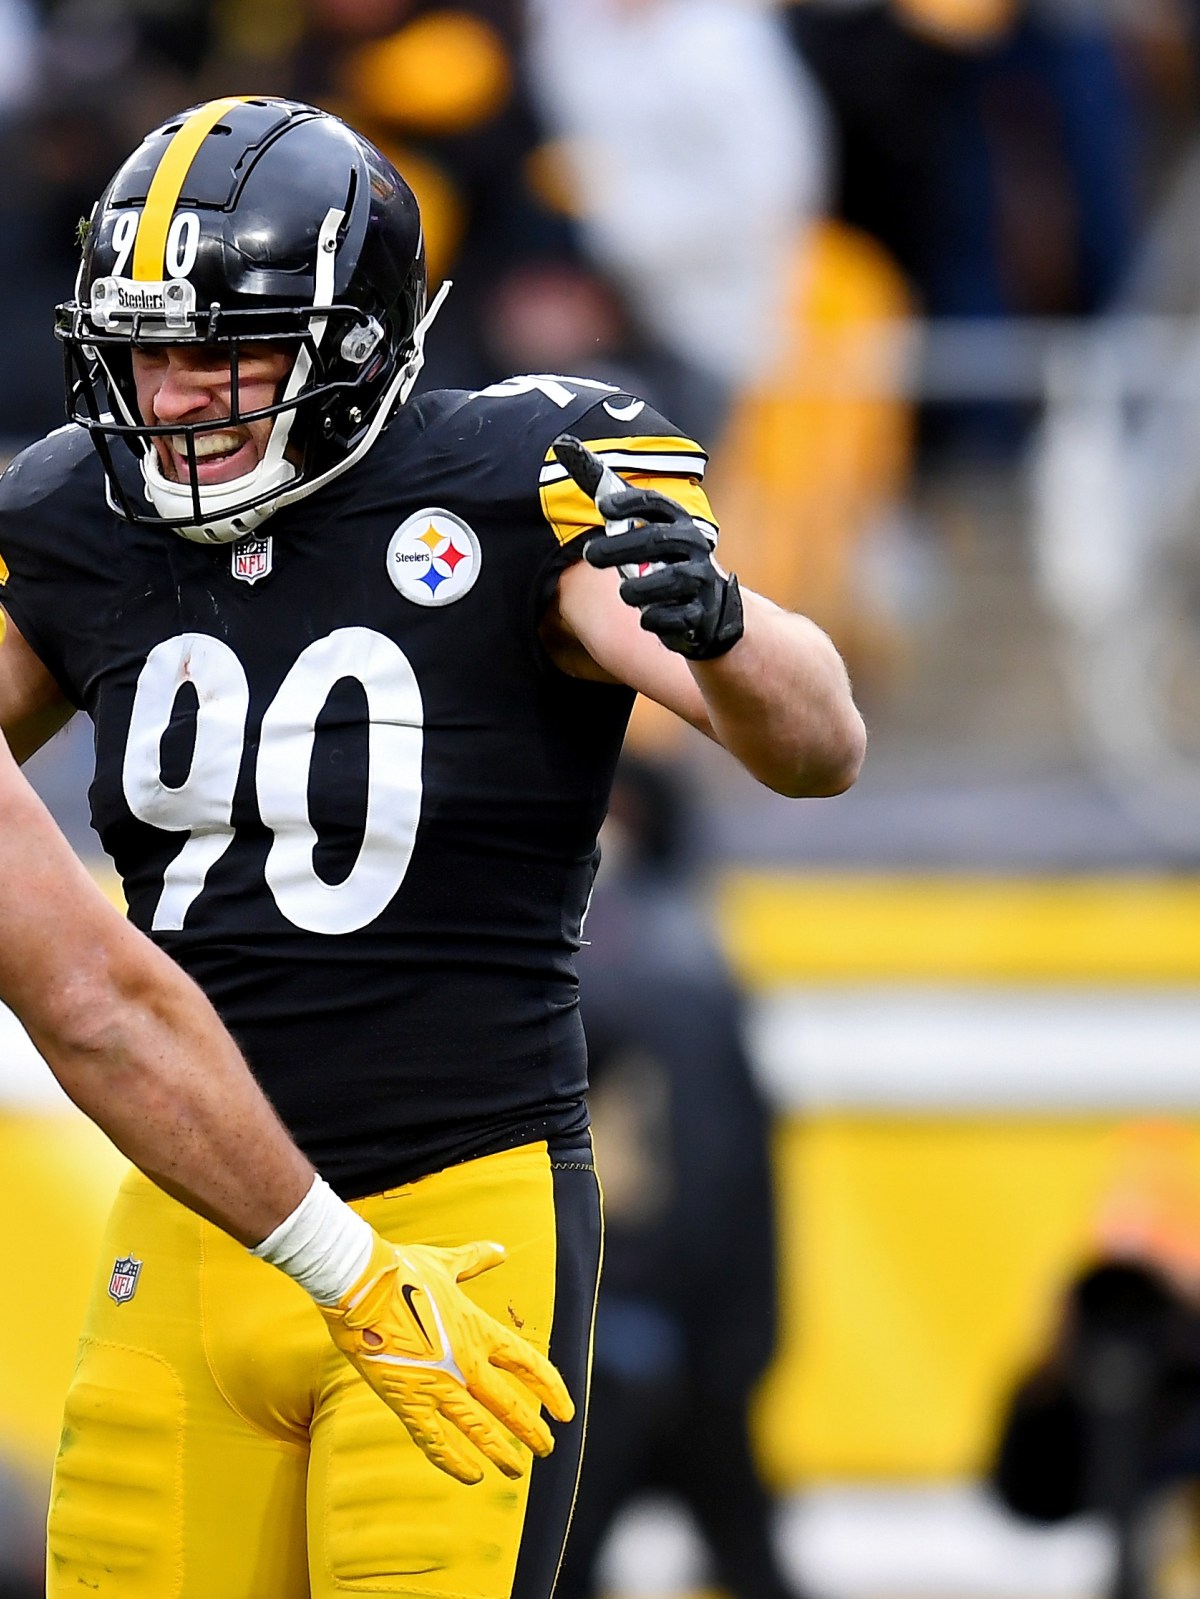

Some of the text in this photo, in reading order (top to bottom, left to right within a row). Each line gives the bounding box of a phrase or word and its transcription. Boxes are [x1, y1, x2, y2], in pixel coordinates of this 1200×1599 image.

[118, 287, 166, 310] Steelers
[237, 554, 265, 575] NFL
[395, 551, 431, 563] Steelers
[122, 625, 425, 935] 90
[111, 1275, 131, 1295] NFL
